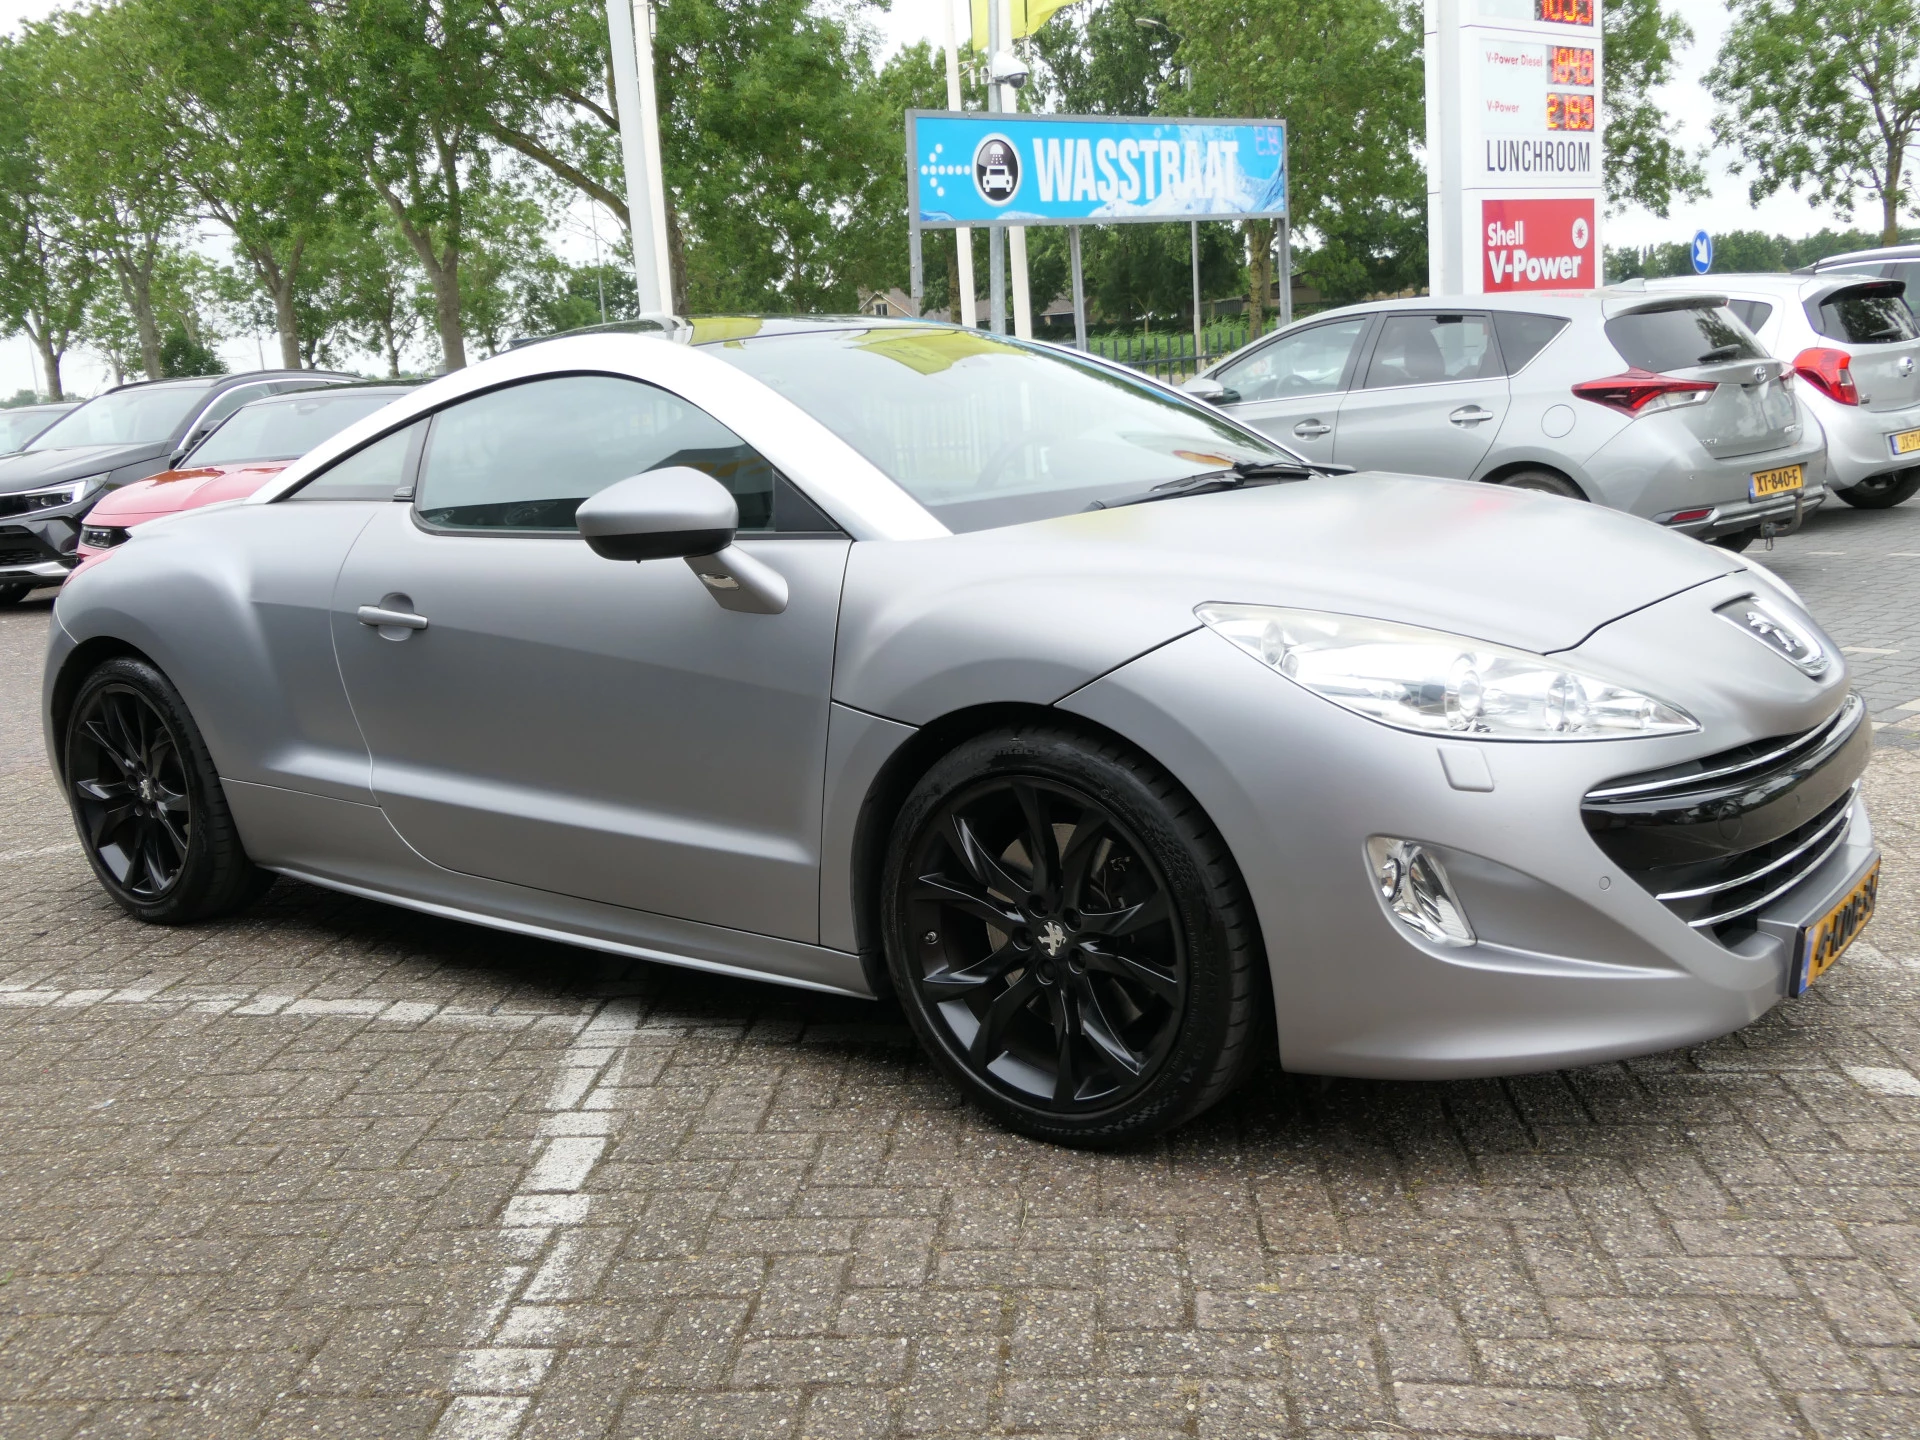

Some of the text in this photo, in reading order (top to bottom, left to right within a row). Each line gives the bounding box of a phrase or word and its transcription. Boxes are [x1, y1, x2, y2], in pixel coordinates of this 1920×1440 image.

[1485, 51, 1543, 68] V-Power Diesel
[1486, 100, 1520, 113] V-Power
[1031, 138, 1239, 202] WASSTRAAT
[1486, 140, 1590, 173] LUNCHROOM
[1487, 220, 1524, 247] Shell
[1487, 249, 1582, 284] V-Power
[1756, 468, 1798, 493] XT-840-F
